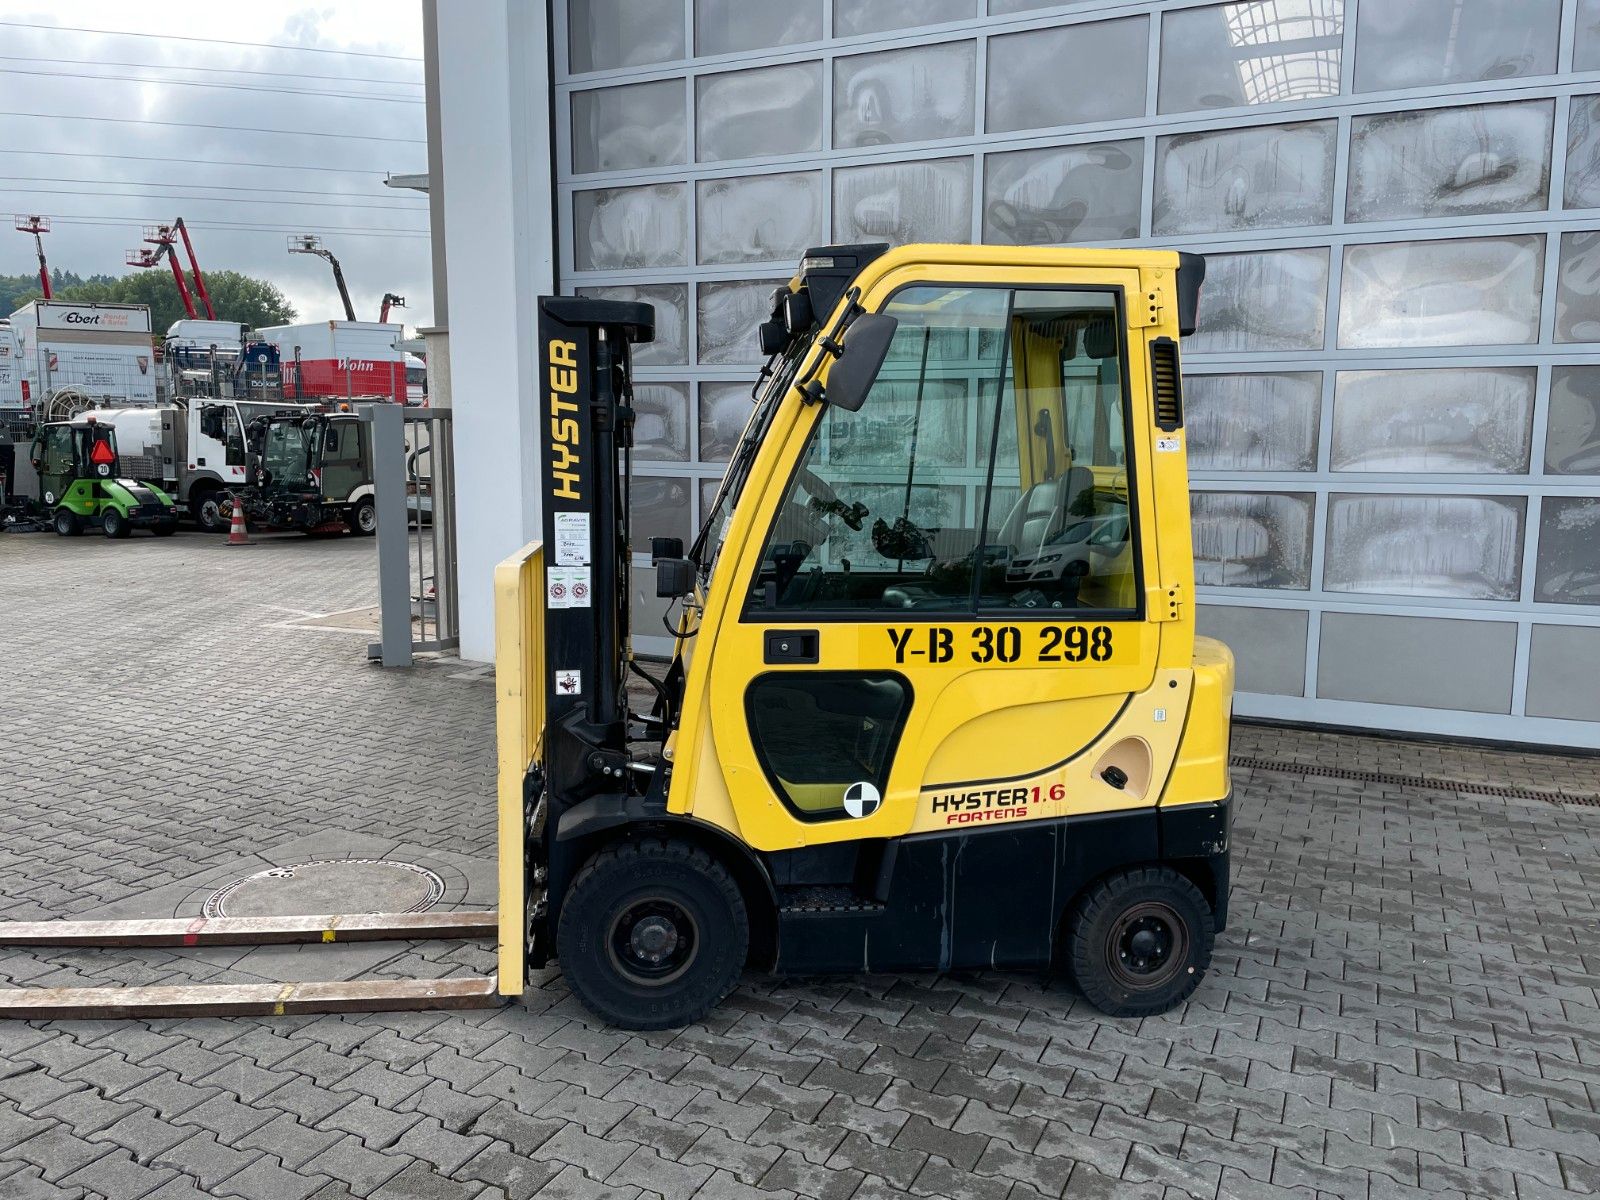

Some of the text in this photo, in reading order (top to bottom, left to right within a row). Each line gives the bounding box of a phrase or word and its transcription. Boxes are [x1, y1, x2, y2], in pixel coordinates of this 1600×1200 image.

[67, 312, 100, 324] Ebert
[337, 359, 374, 372] Wohn
[549, 339, 581, 500] HYSTER
[100, 465, 107, 474] 20
[887, 626, 1113, 664] Y-B 30 298
[932, 784, 1066, 813] HYSTER 1.6
[947, 807, 1028, 824] FORTENS
